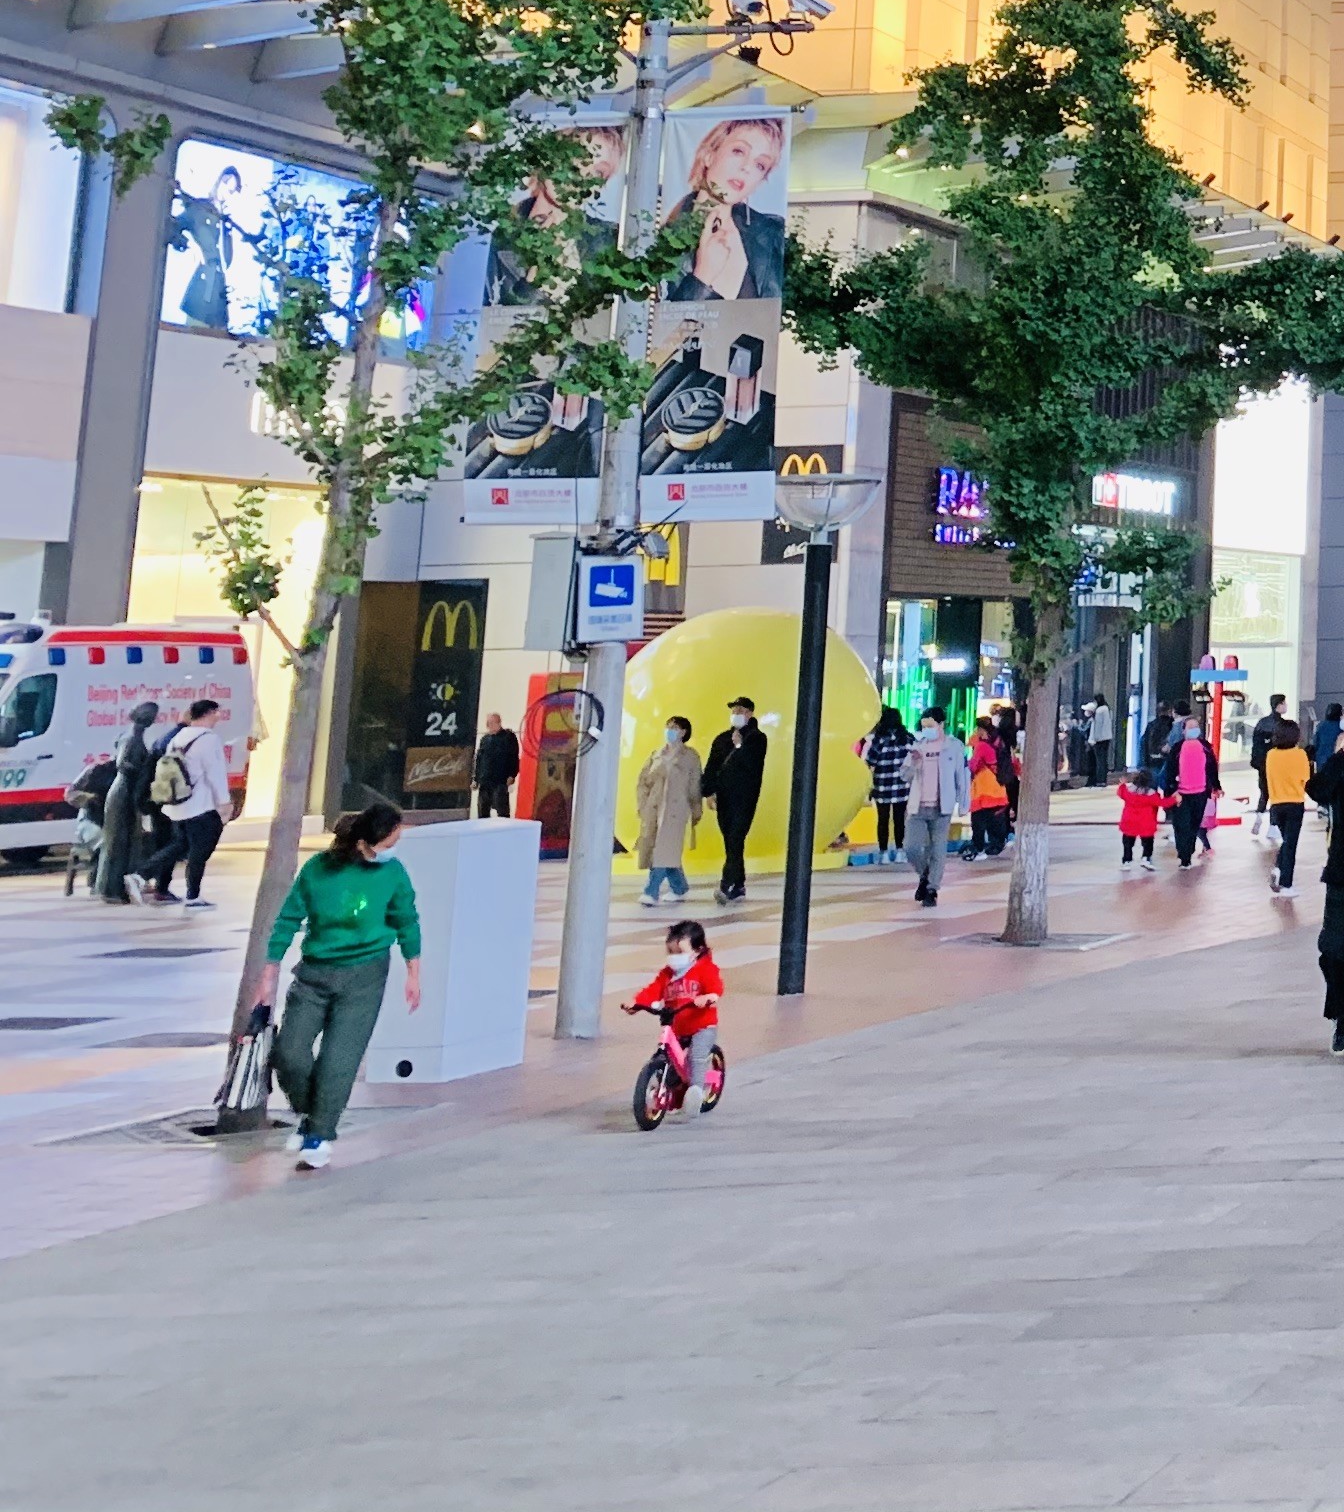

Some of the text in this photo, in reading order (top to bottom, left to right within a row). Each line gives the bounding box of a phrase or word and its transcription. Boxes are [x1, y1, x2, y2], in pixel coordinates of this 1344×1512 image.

[88, 683, 118, 705] Beijing
[209, 682, 231, 699] China
[425, 711, 458, 736] 24
